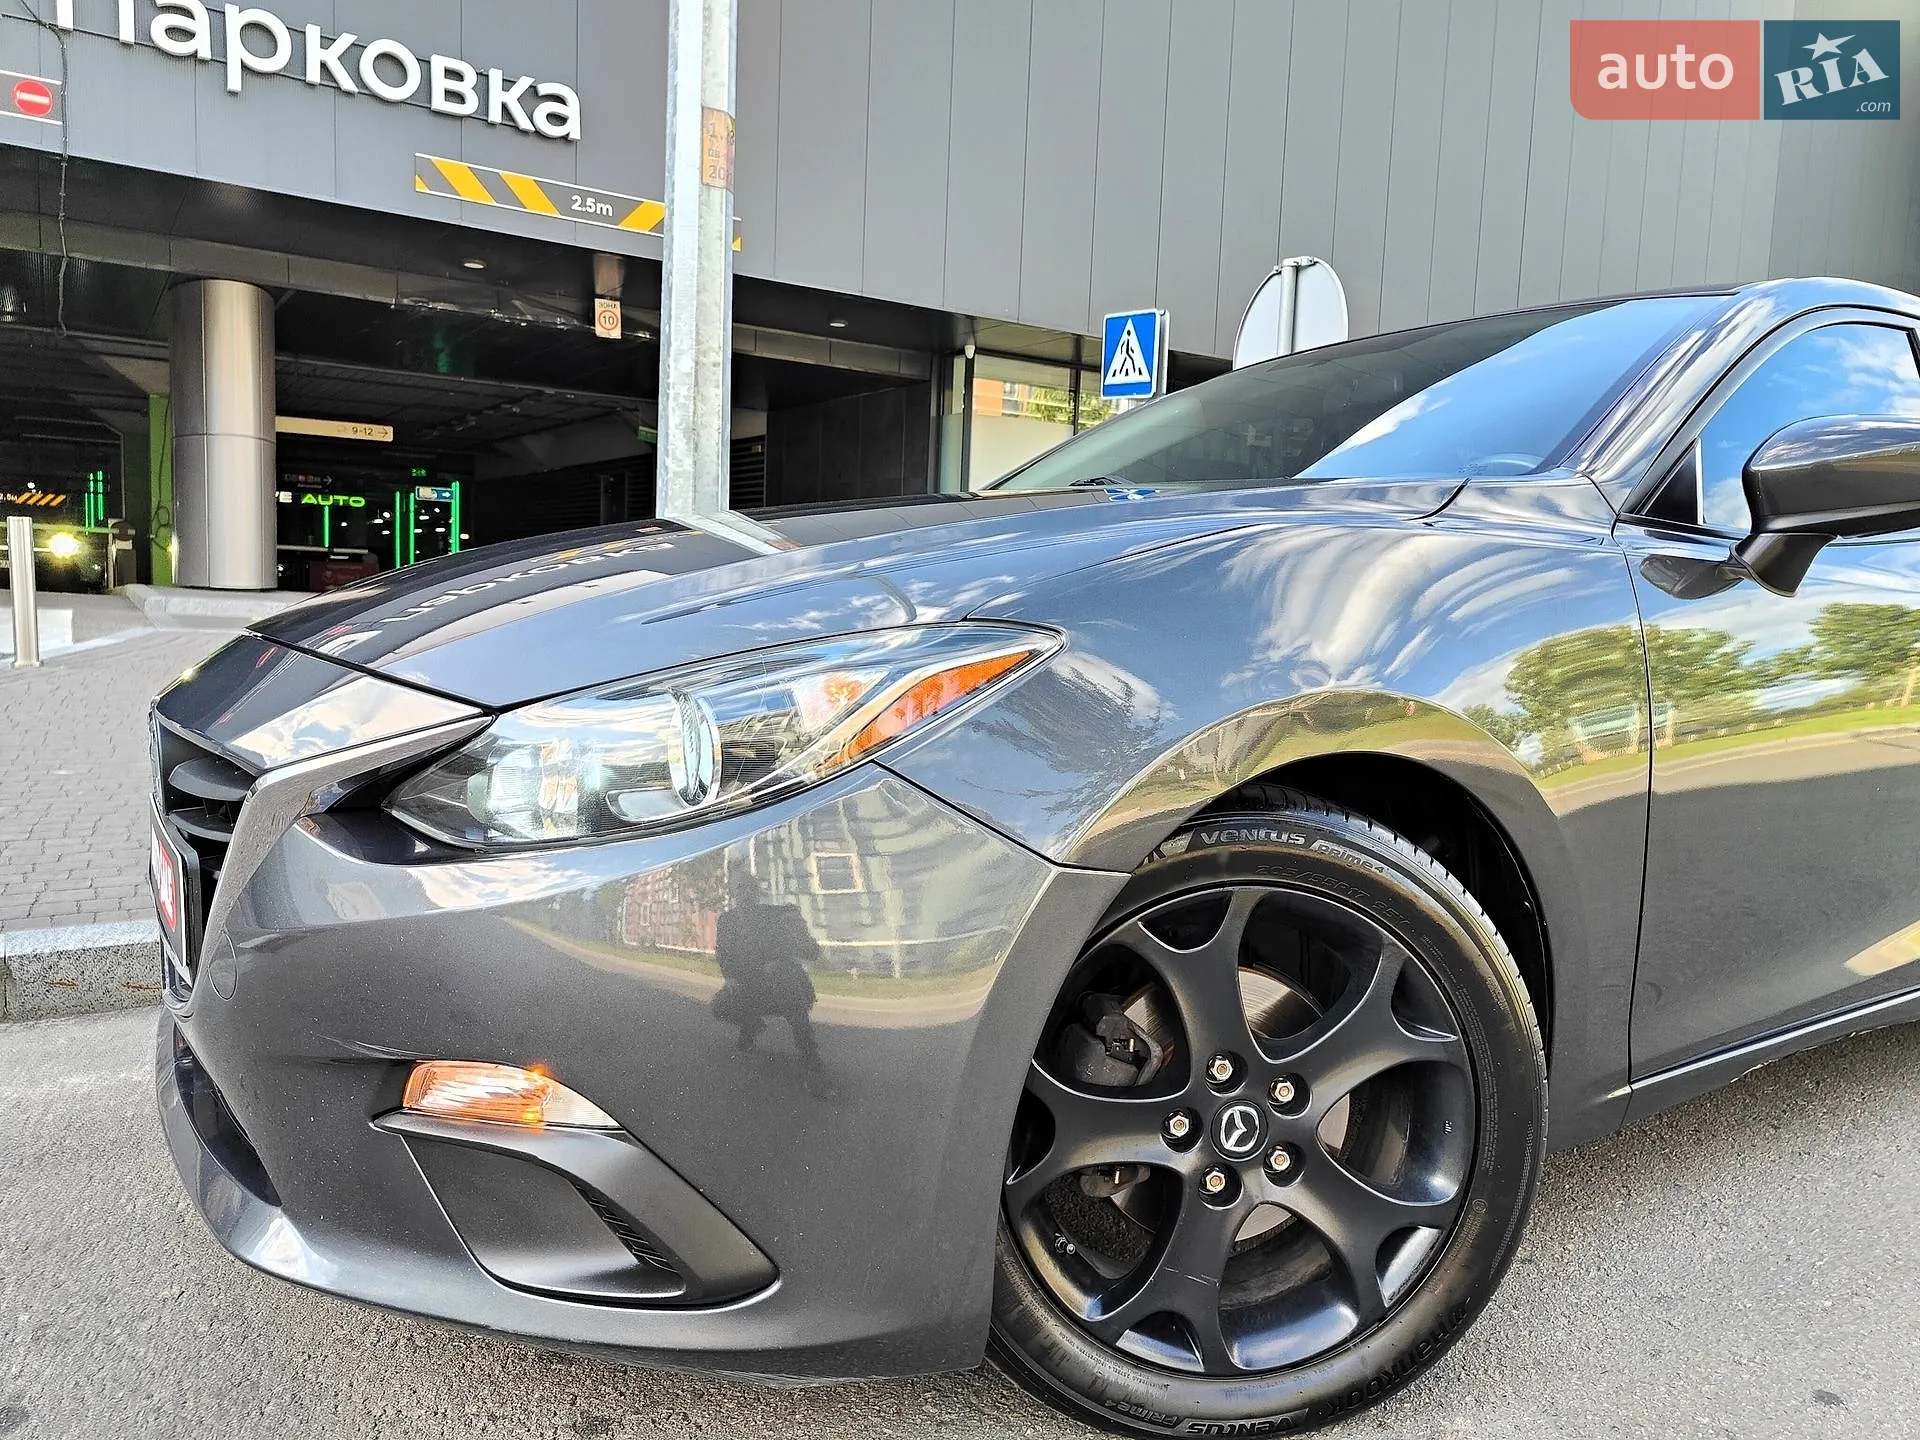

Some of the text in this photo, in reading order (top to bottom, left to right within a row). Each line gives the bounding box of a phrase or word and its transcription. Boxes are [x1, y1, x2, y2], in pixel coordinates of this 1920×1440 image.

[571, 194, 613, 217] 2.5m
[602, 315, 615, 326] 10
[351, 426, 373, 437] 9-12
[301, 493, 366, 508] AUTO
